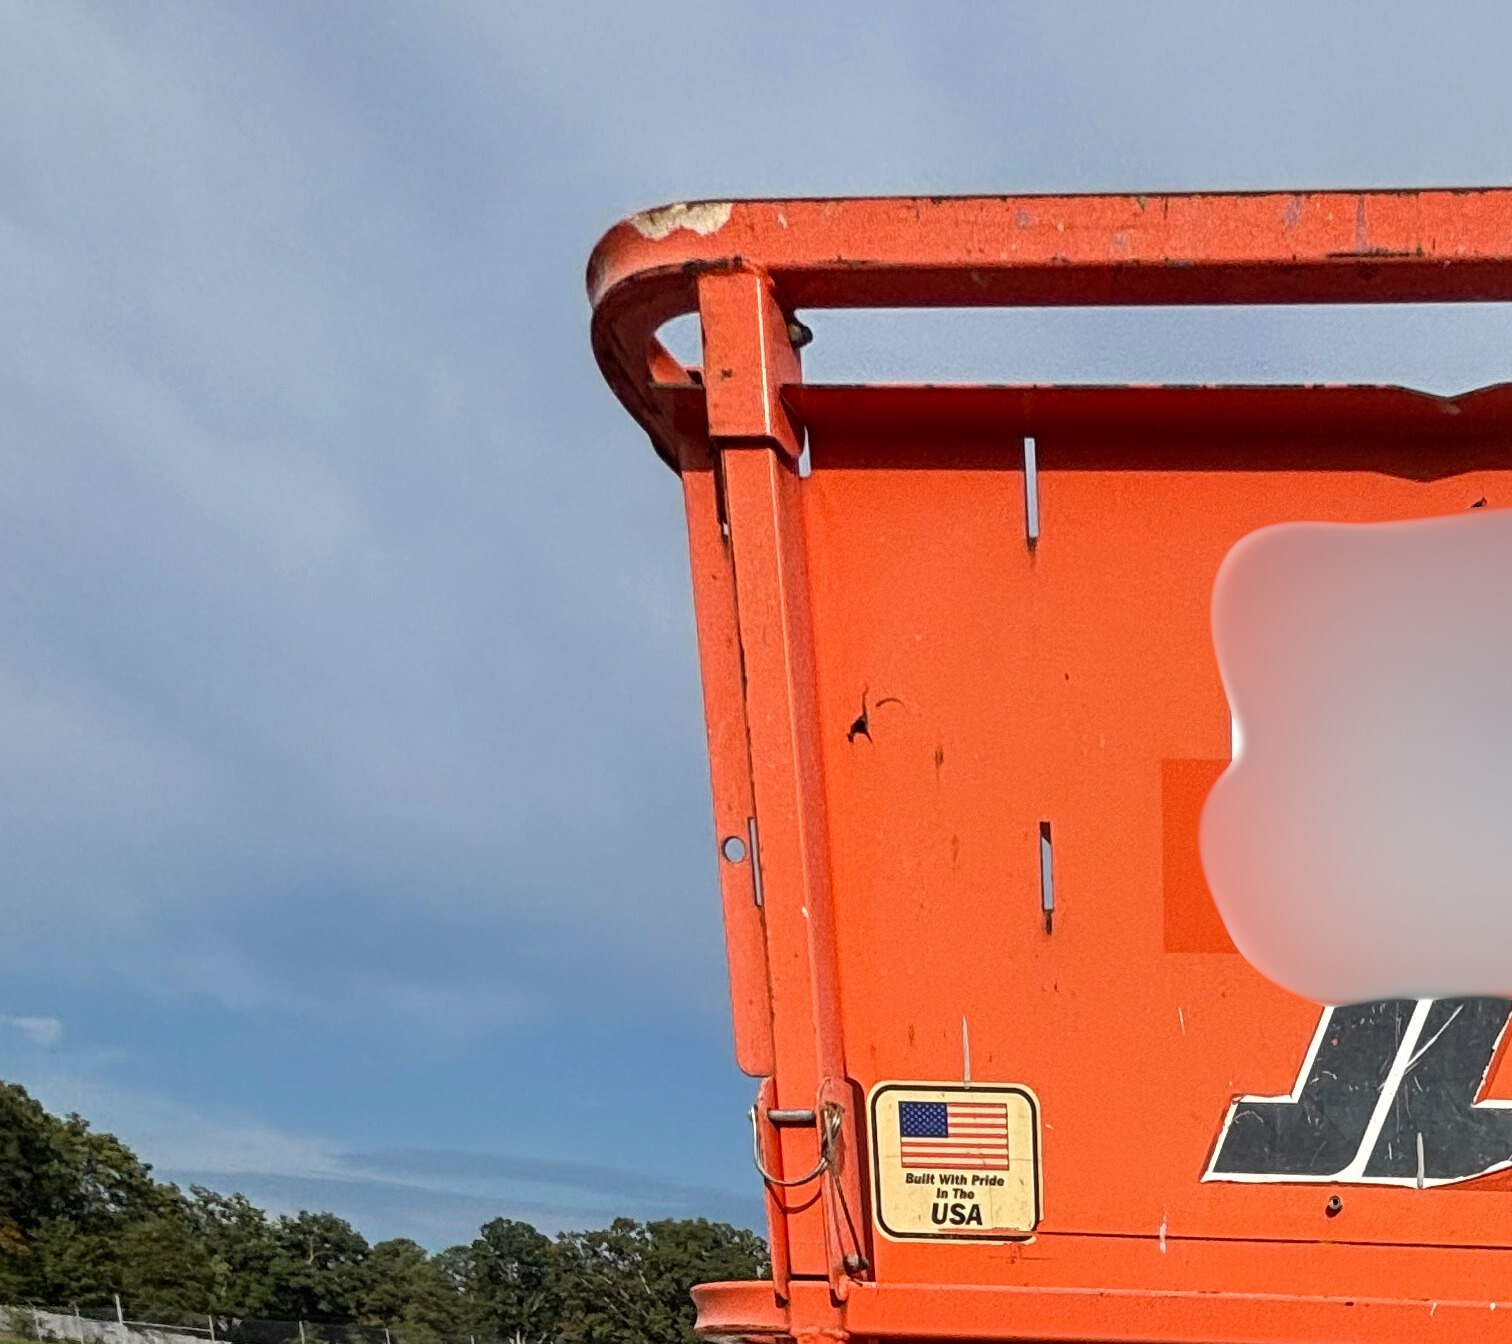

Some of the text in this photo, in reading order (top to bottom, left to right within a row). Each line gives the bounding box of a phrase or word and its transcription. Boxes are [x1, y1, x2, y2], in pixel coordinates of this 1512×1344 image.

[905, 1173, 1005, 1187] Built With Pride
[936, 1188, 975, 1200] In The
[931, 1203, 983, 1226] USA
